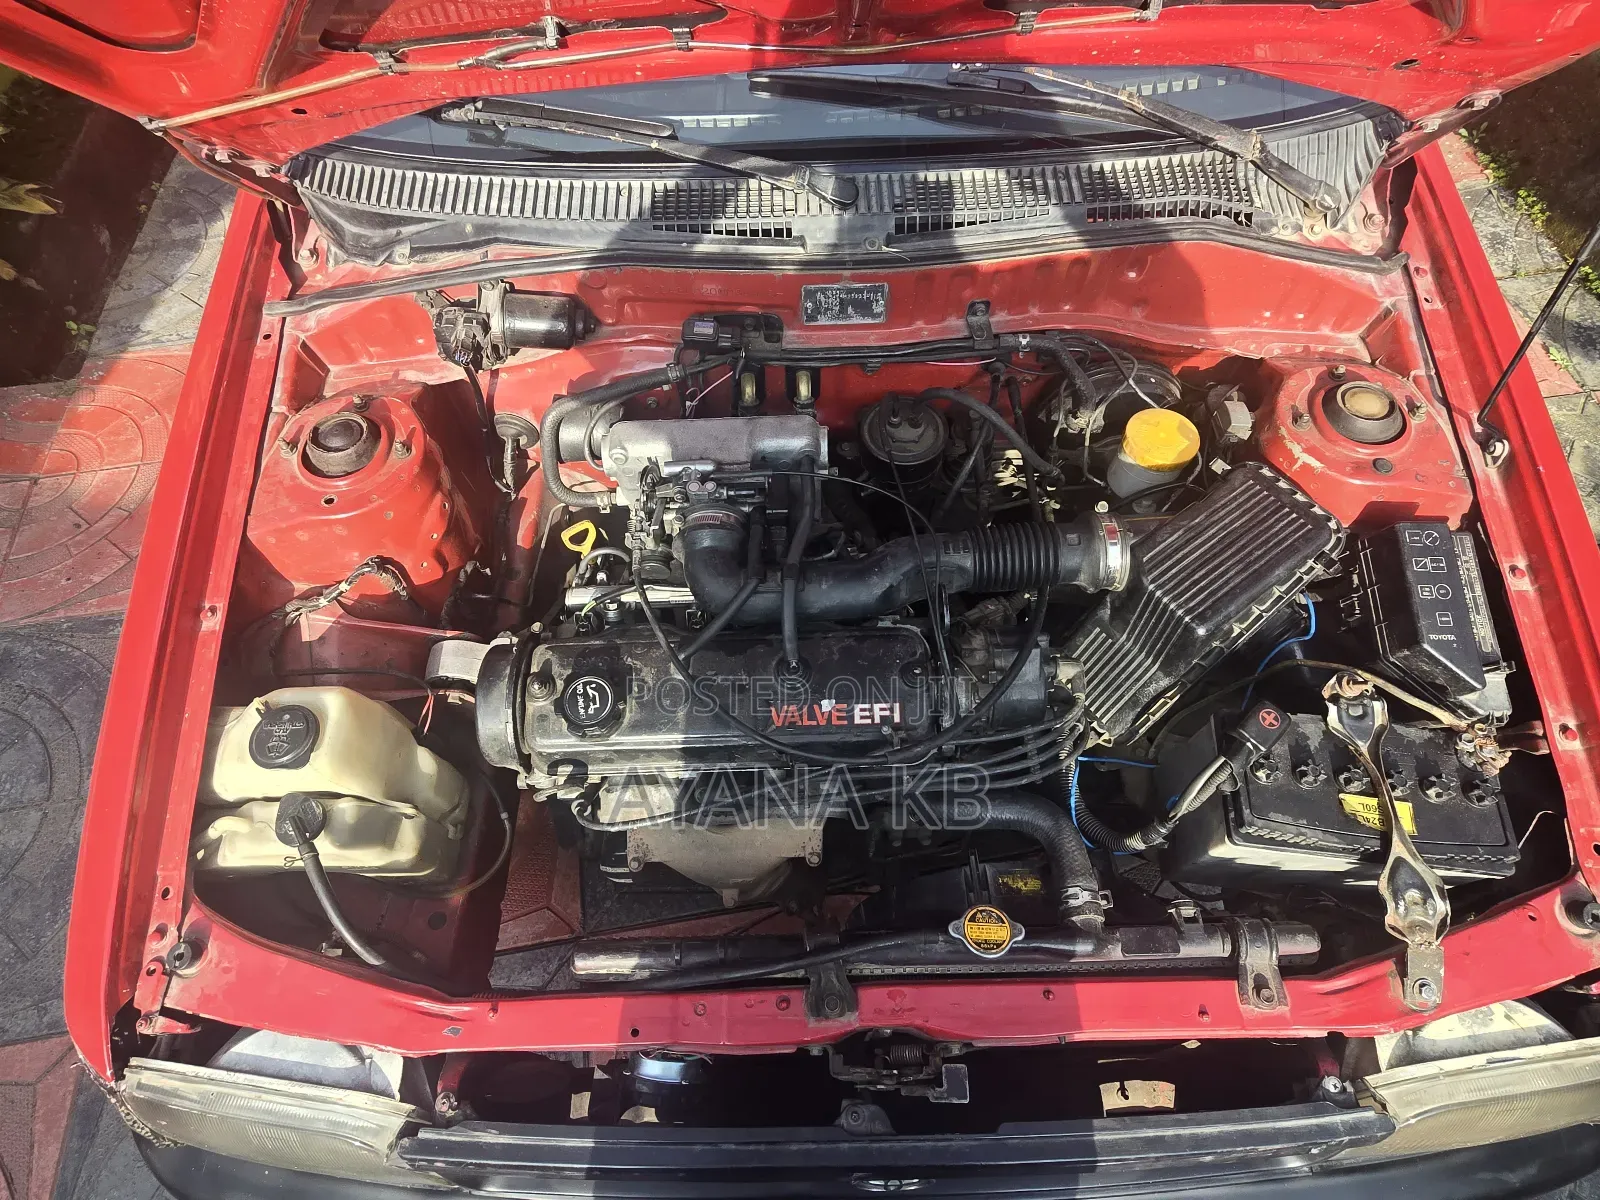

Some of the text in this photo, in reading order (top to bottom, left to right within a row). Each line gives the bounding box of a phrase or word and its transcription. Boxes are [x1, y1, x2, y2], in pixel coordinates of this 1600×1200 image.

[577, 695, 586, 719] ENGINE
[770, 702, 901, 727] VALVE EFI
